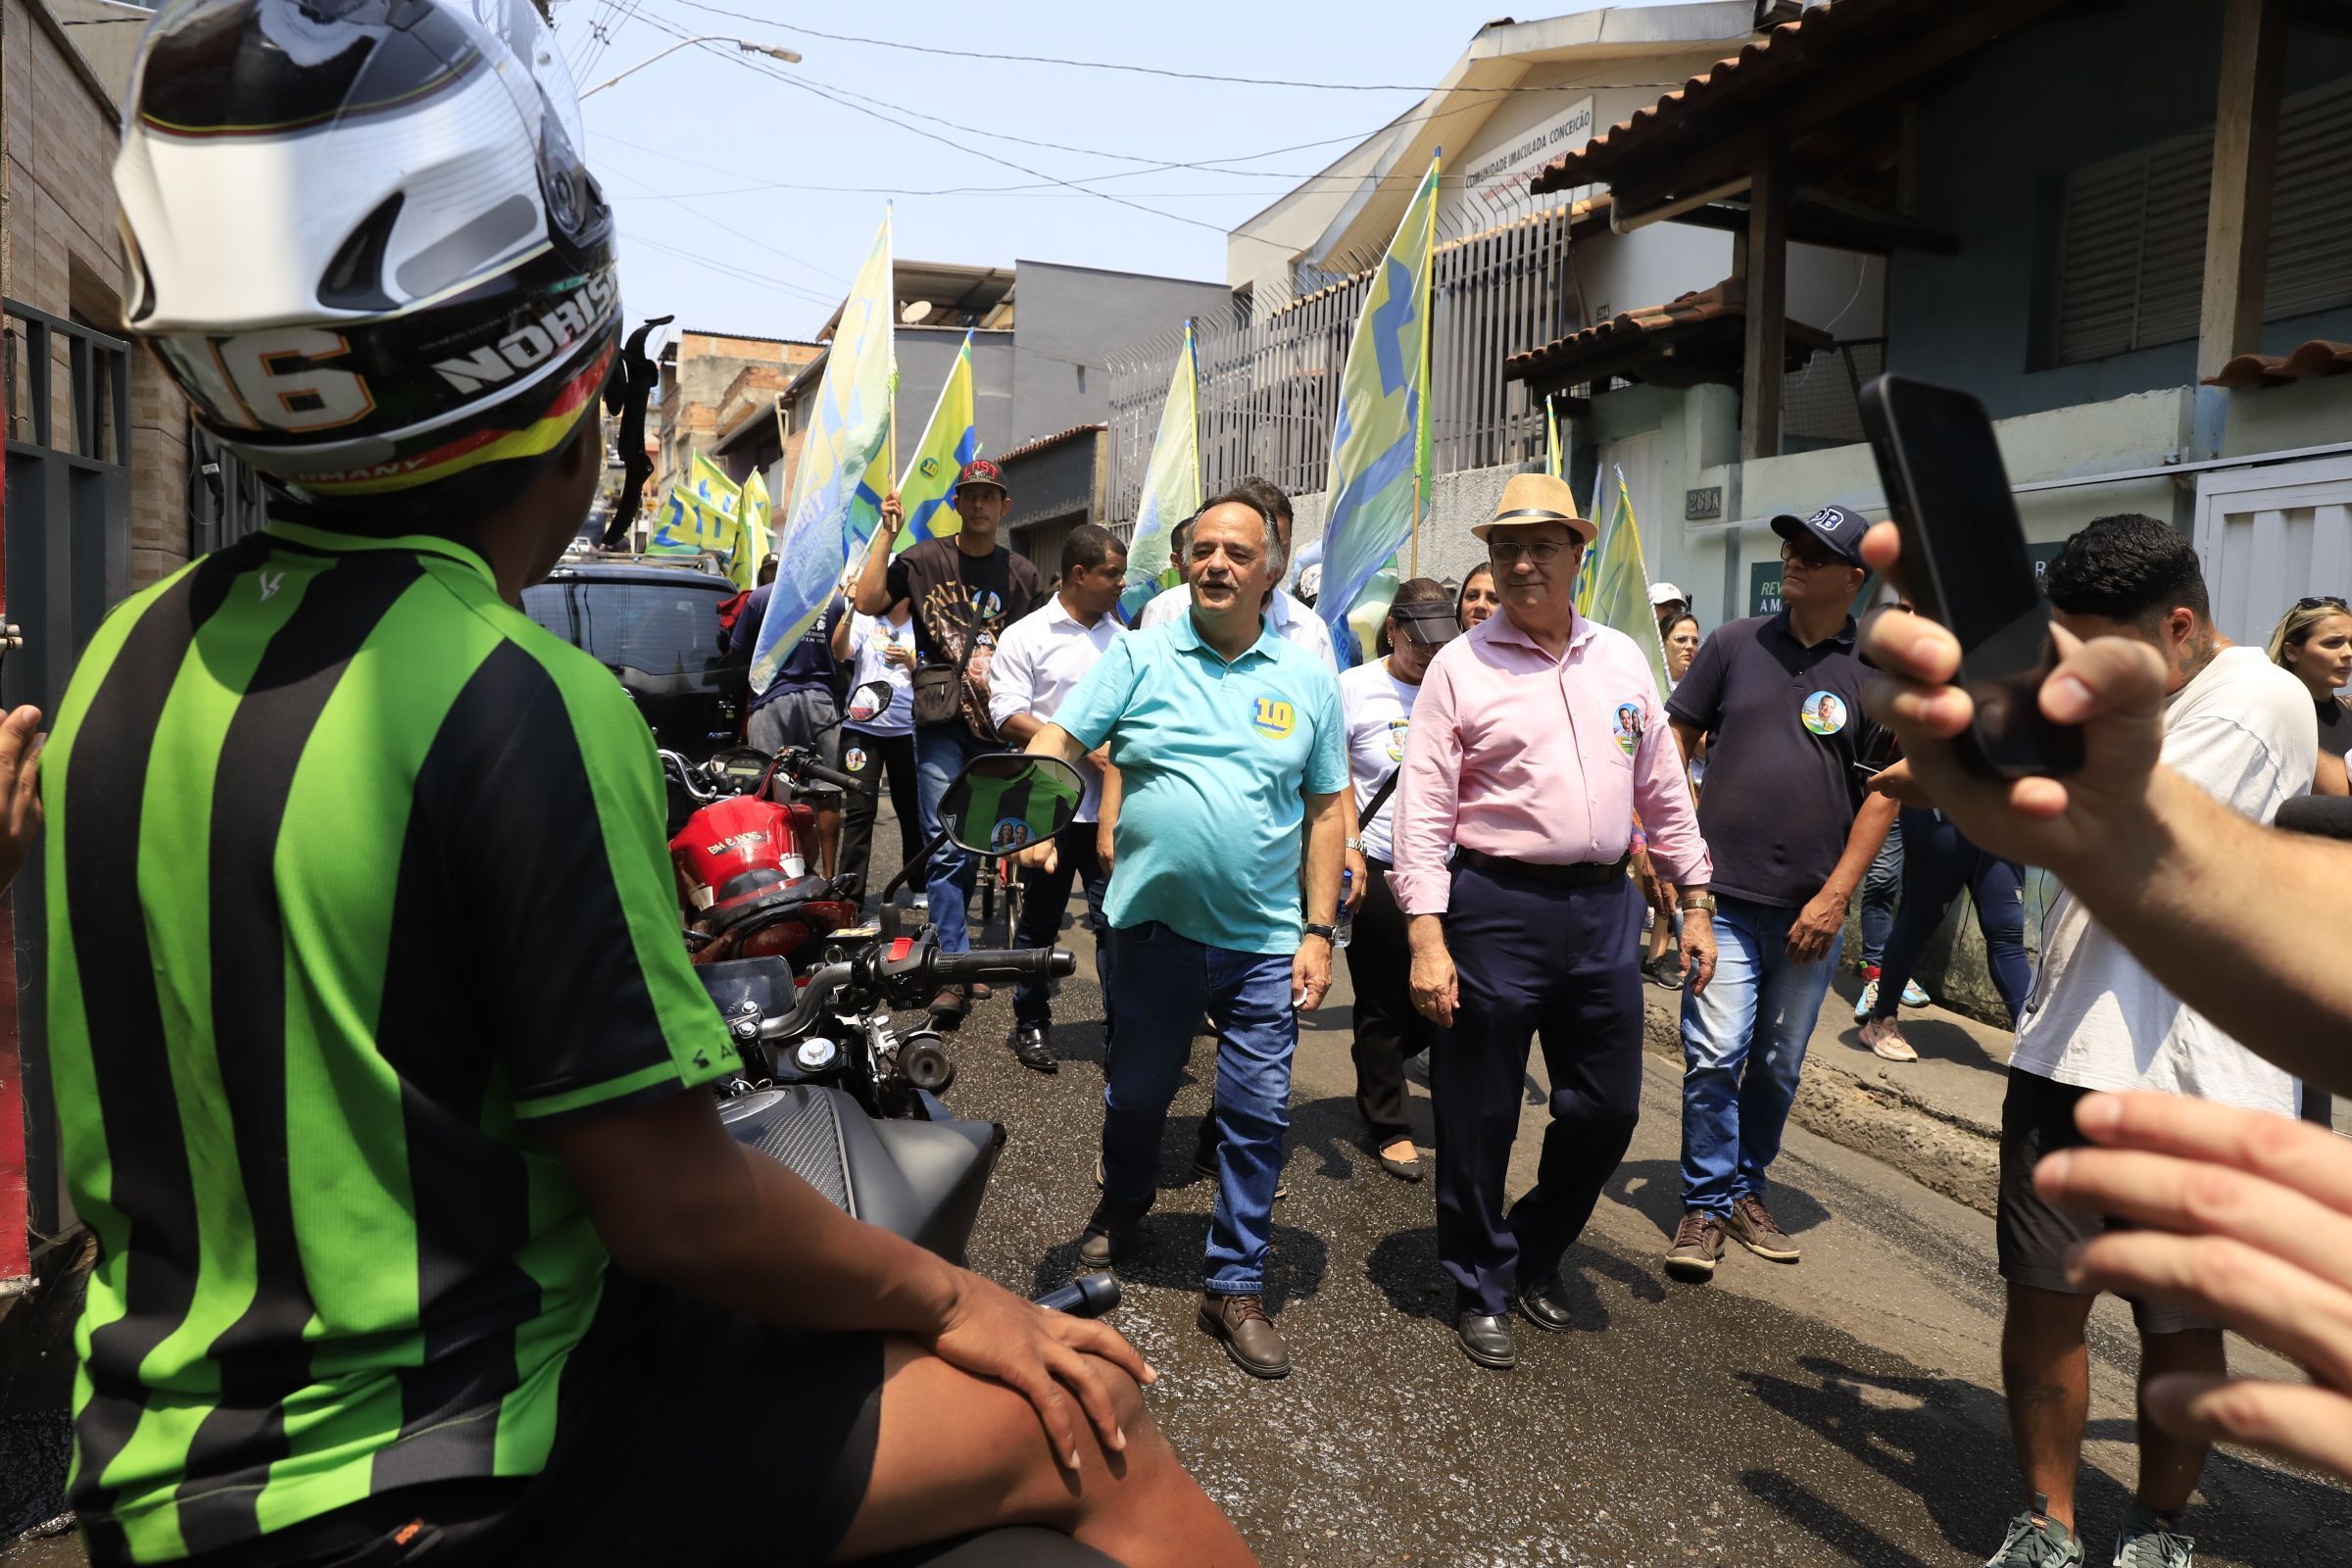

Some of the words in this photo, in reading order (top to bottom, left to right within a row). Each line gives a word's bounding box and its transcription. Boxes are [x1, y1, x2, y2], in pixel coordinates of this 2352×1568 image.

[1465, 156, 1507, 188] COMUNIDADE
[1509, 134, 1546, 168] IMACULADA
[1254, 697, 1293, 732] 10
